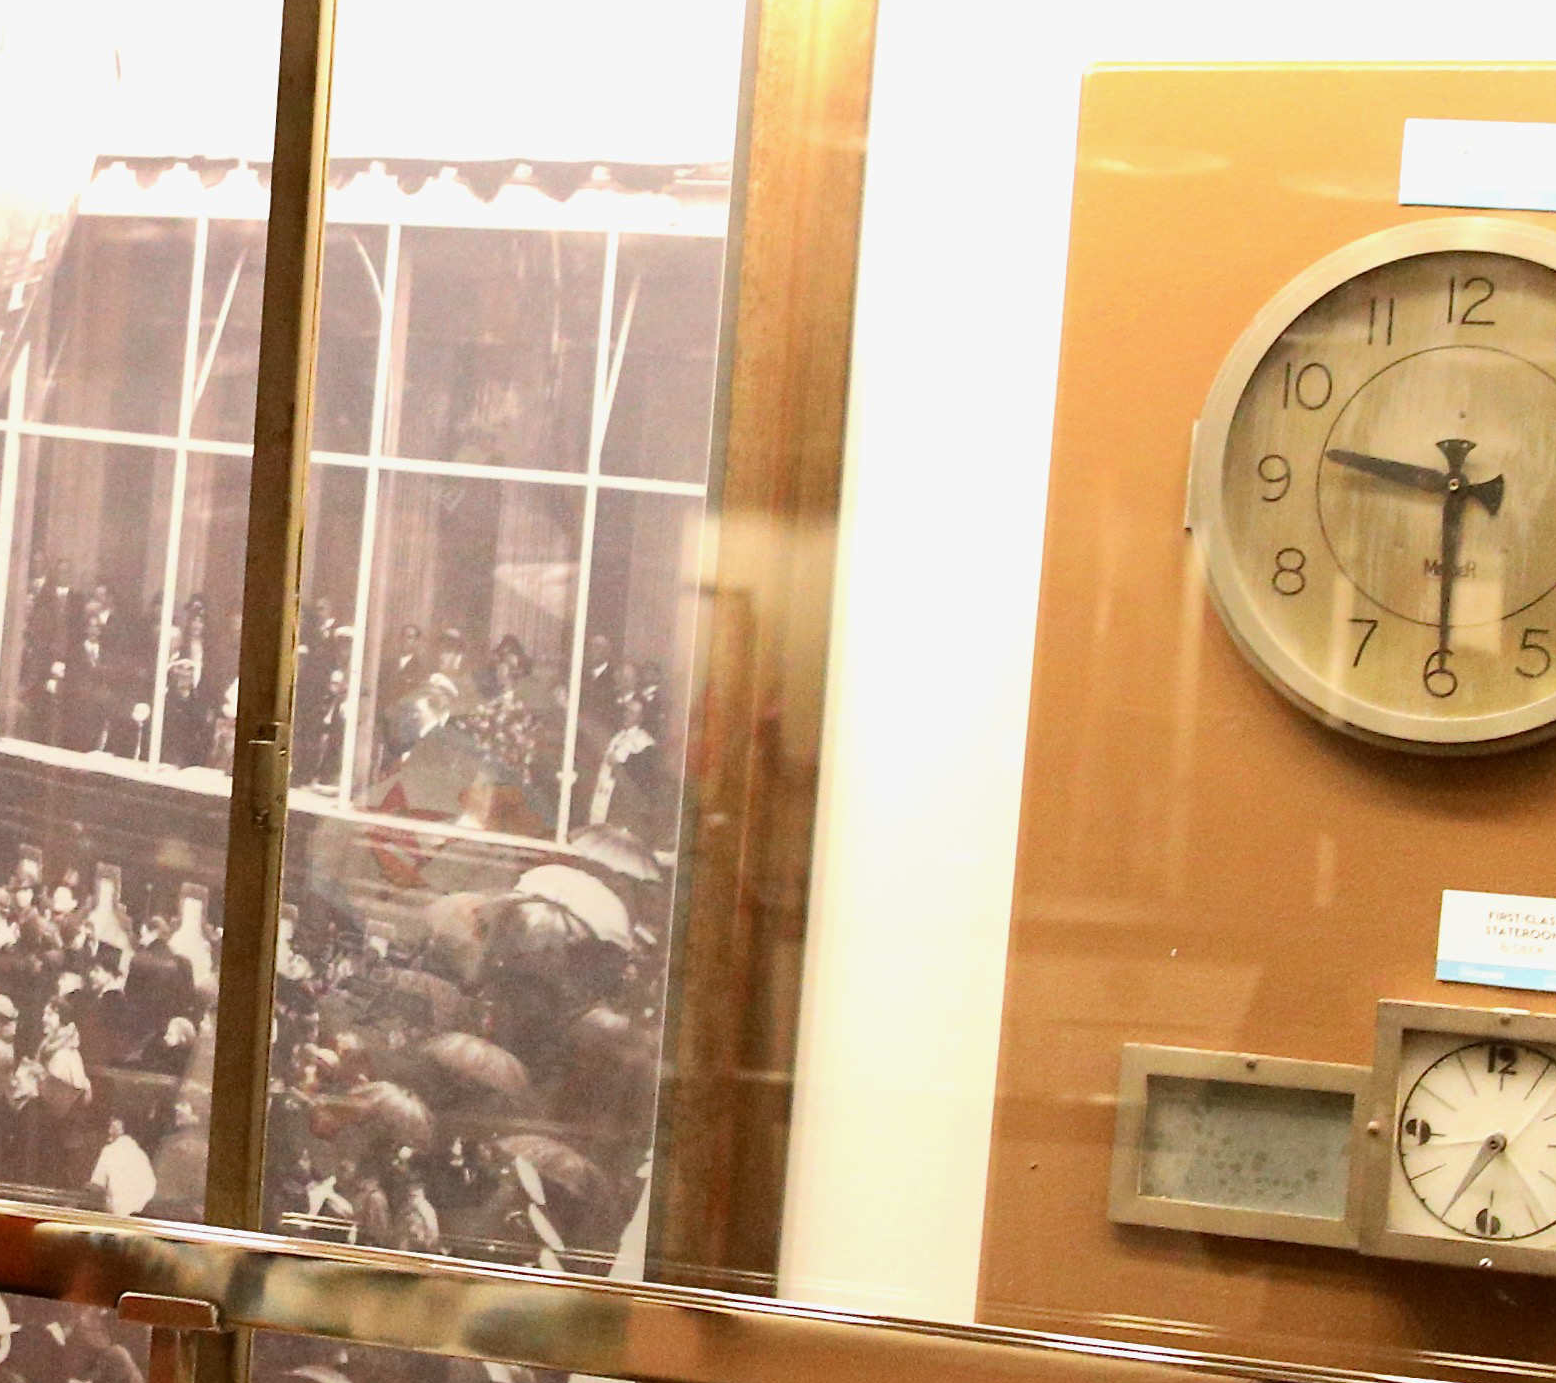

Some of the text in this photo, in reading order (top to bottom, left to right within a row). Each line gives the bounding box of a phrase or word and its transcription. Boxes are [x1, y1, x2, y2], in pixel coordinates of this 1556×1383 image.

[1368, 297, 1394, 345] 11
[1449, 276, 1495, 326] 12
[1283, 363, 1333, 410] 10
[1257, 454, 1291, 501] 9
[1272, 548, 1306, 596] 8
[1349, 618, 1378, 667] 7
[1515, 628, 1552, 678] 5
[1423, 649, 1457, 698] 6
